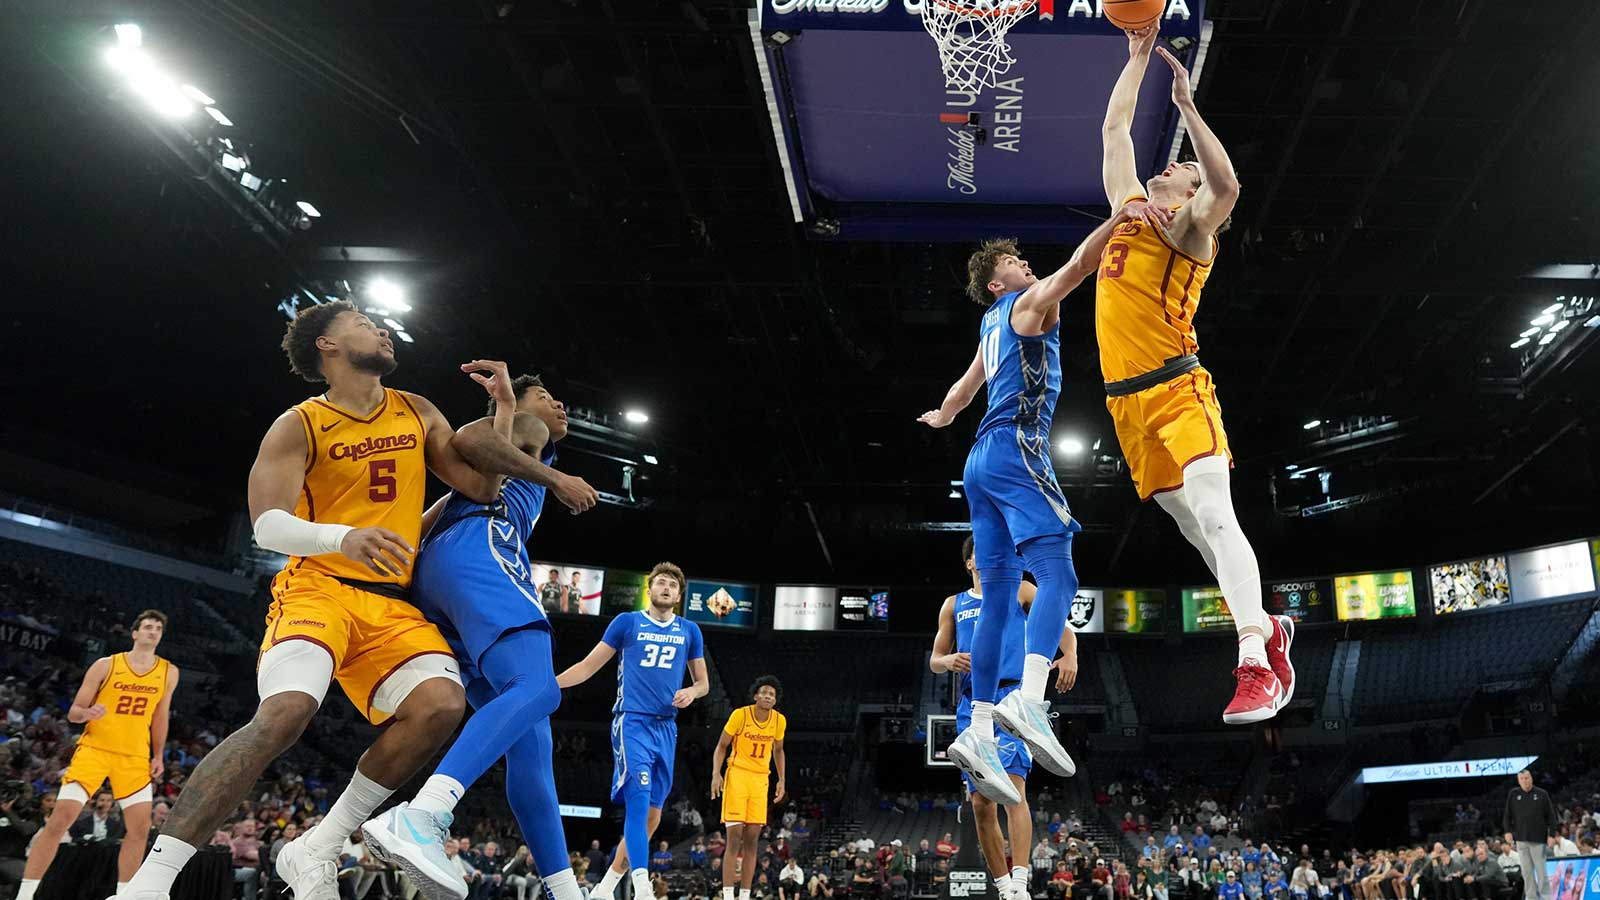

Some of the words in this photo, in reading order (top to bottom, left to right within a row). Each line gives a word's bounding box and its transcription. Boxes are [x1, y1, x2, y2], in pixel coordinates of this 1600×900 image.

[993, 77, 1024, 152] ARENA
[947, 126, 977, 194] Michelob
[329, 433, 417, 462] Cyclones
[368, 459, 397, 503] 5
[1272, 582, 1316, 593] DISCOVER
[288, 618, 326, 628] Cyclones
[637, 632, 685, 645] CREIGHTON
[640, 644, 677, 669] 32
[113, 681, 159, 694] Cyclones
[115, 696, 148, 716] 22
[1324, 720, 1339, 730] 124
[750, 743, 766, 759] 11
[1423, 764, 1460, 776] ULTRA
[1475, 761, 1514, 773] ARENA
[949, 871, 987, 880] GEICO
